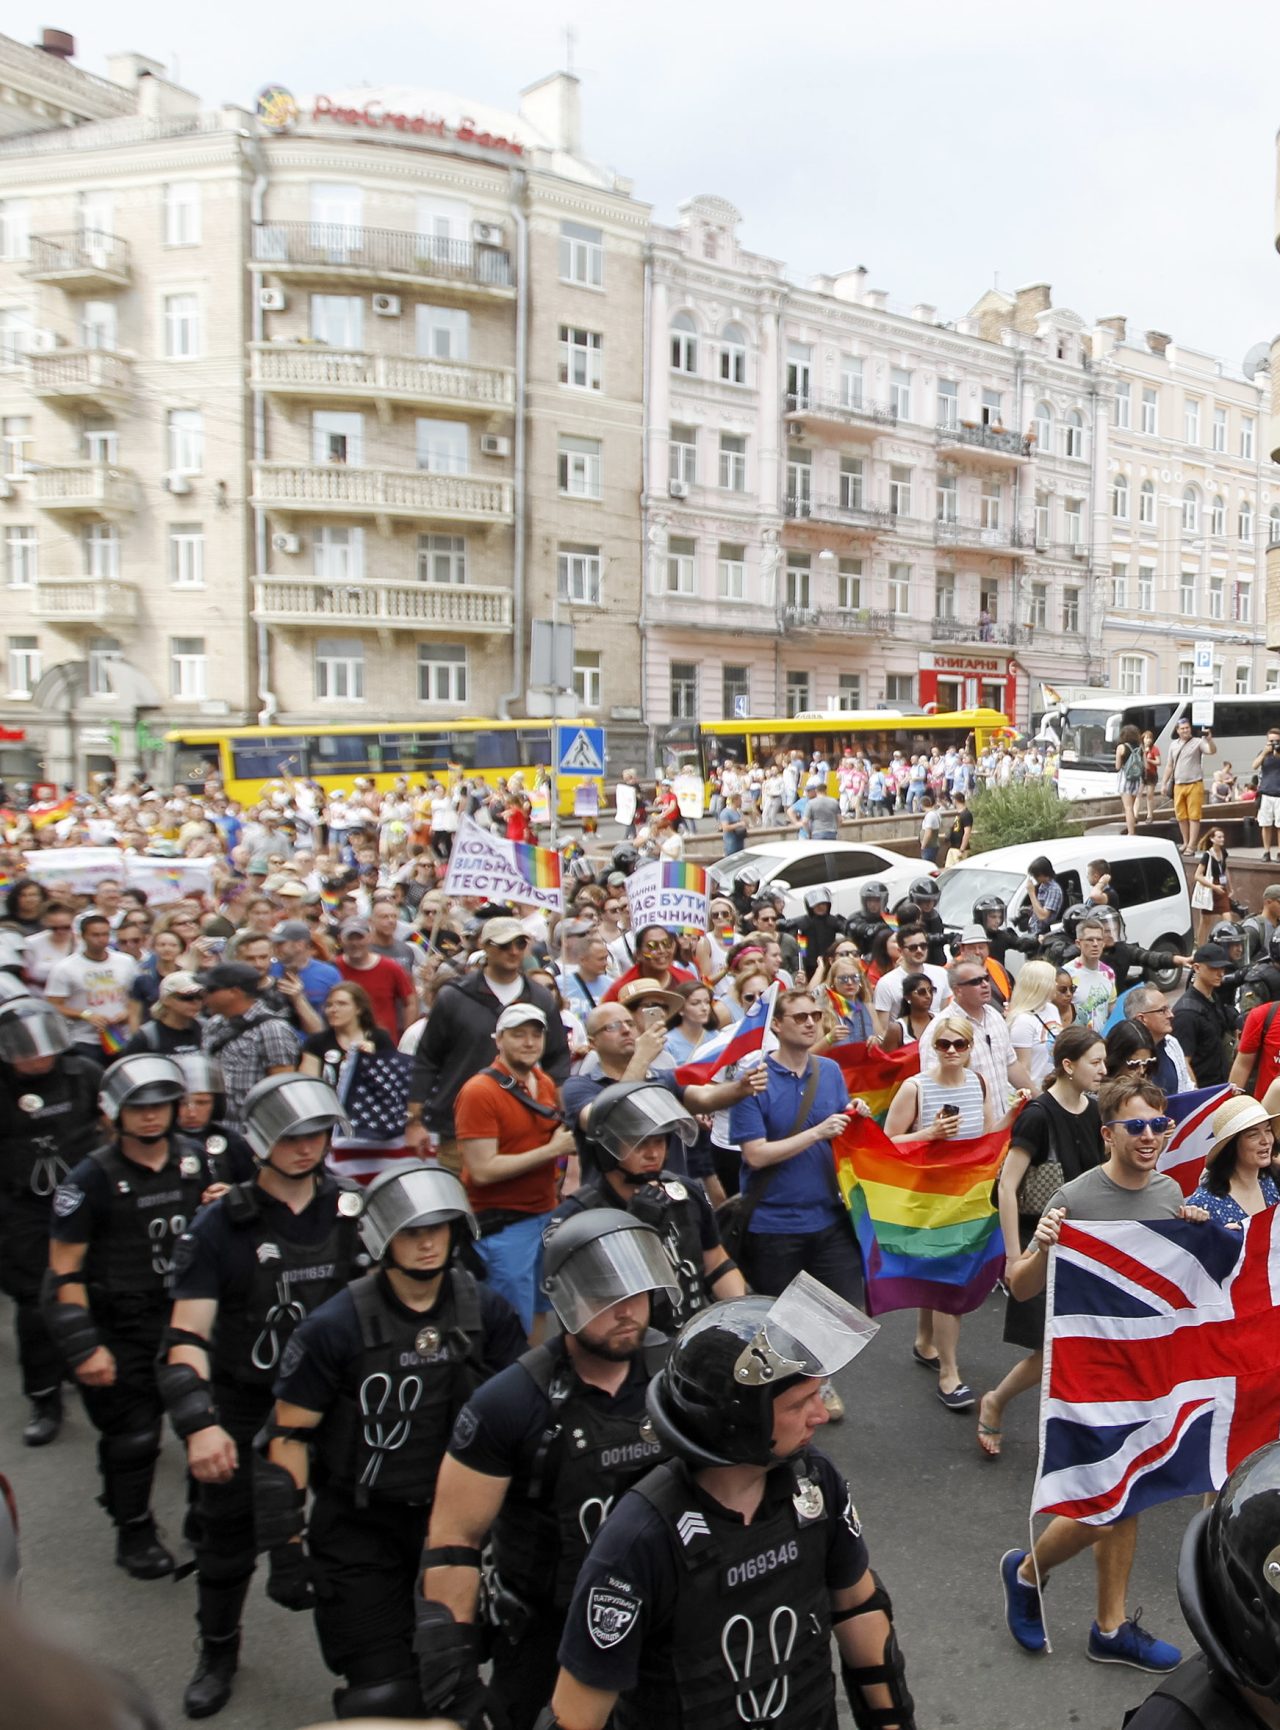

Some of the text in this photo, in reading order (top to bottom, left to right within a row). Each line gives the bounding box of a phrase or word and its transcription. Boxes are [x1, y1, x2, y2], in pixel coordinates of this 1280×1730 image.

[934, 656, 998, 671] КНИГАРНЯ
[631, 893, 705, 914] АЄ БУТИ
[727, 1540, 799, 1587] 0169346
